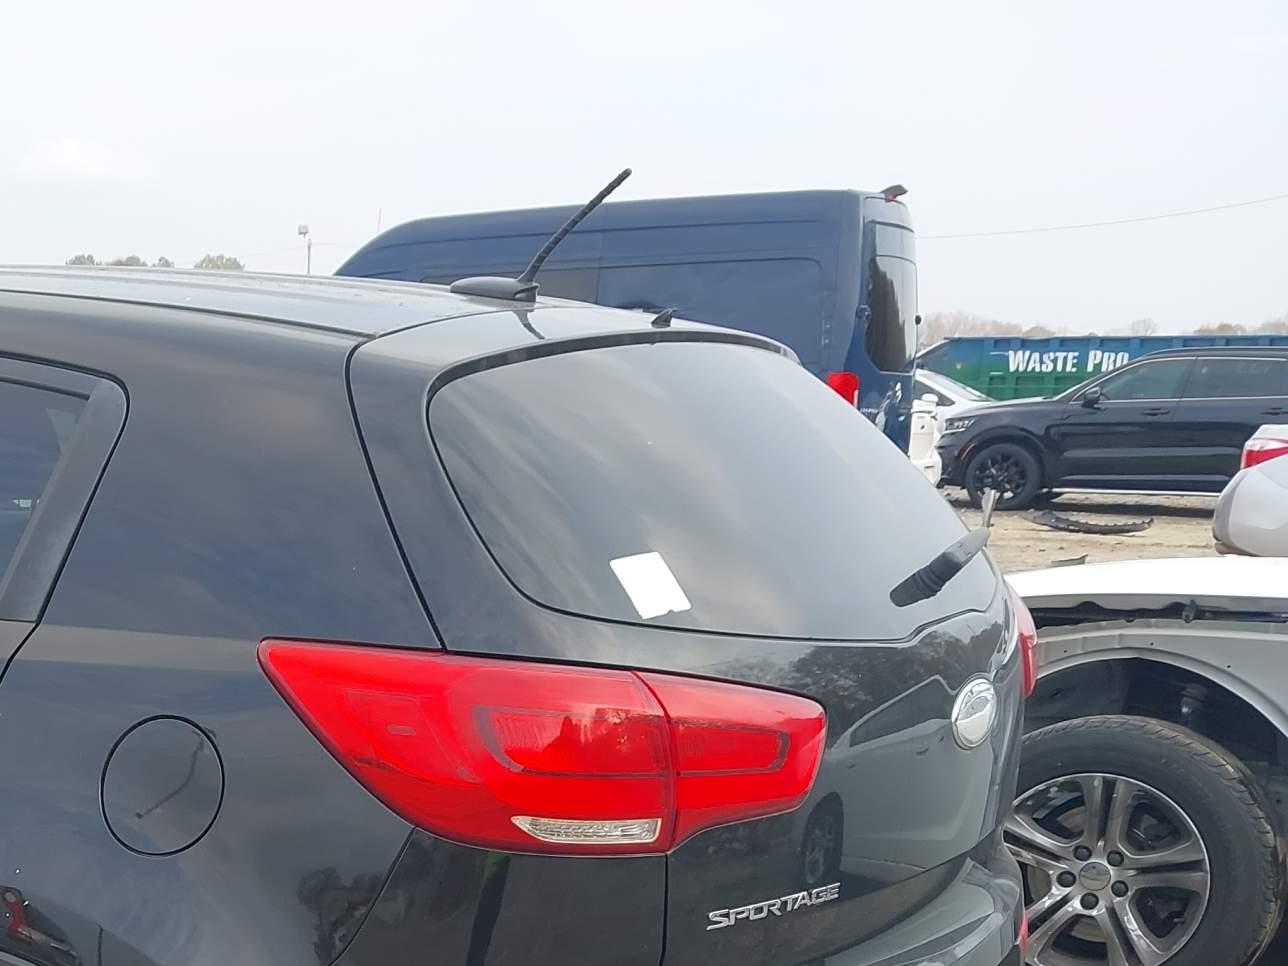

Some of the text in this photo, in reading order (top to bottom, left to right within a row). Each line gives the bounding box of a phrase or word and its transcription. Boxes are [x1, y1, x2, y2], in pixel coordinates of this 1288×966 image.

[1008, 350, 1130, 372] WASTE PRO
[706, 882, 841, 931] SPORTAGE
